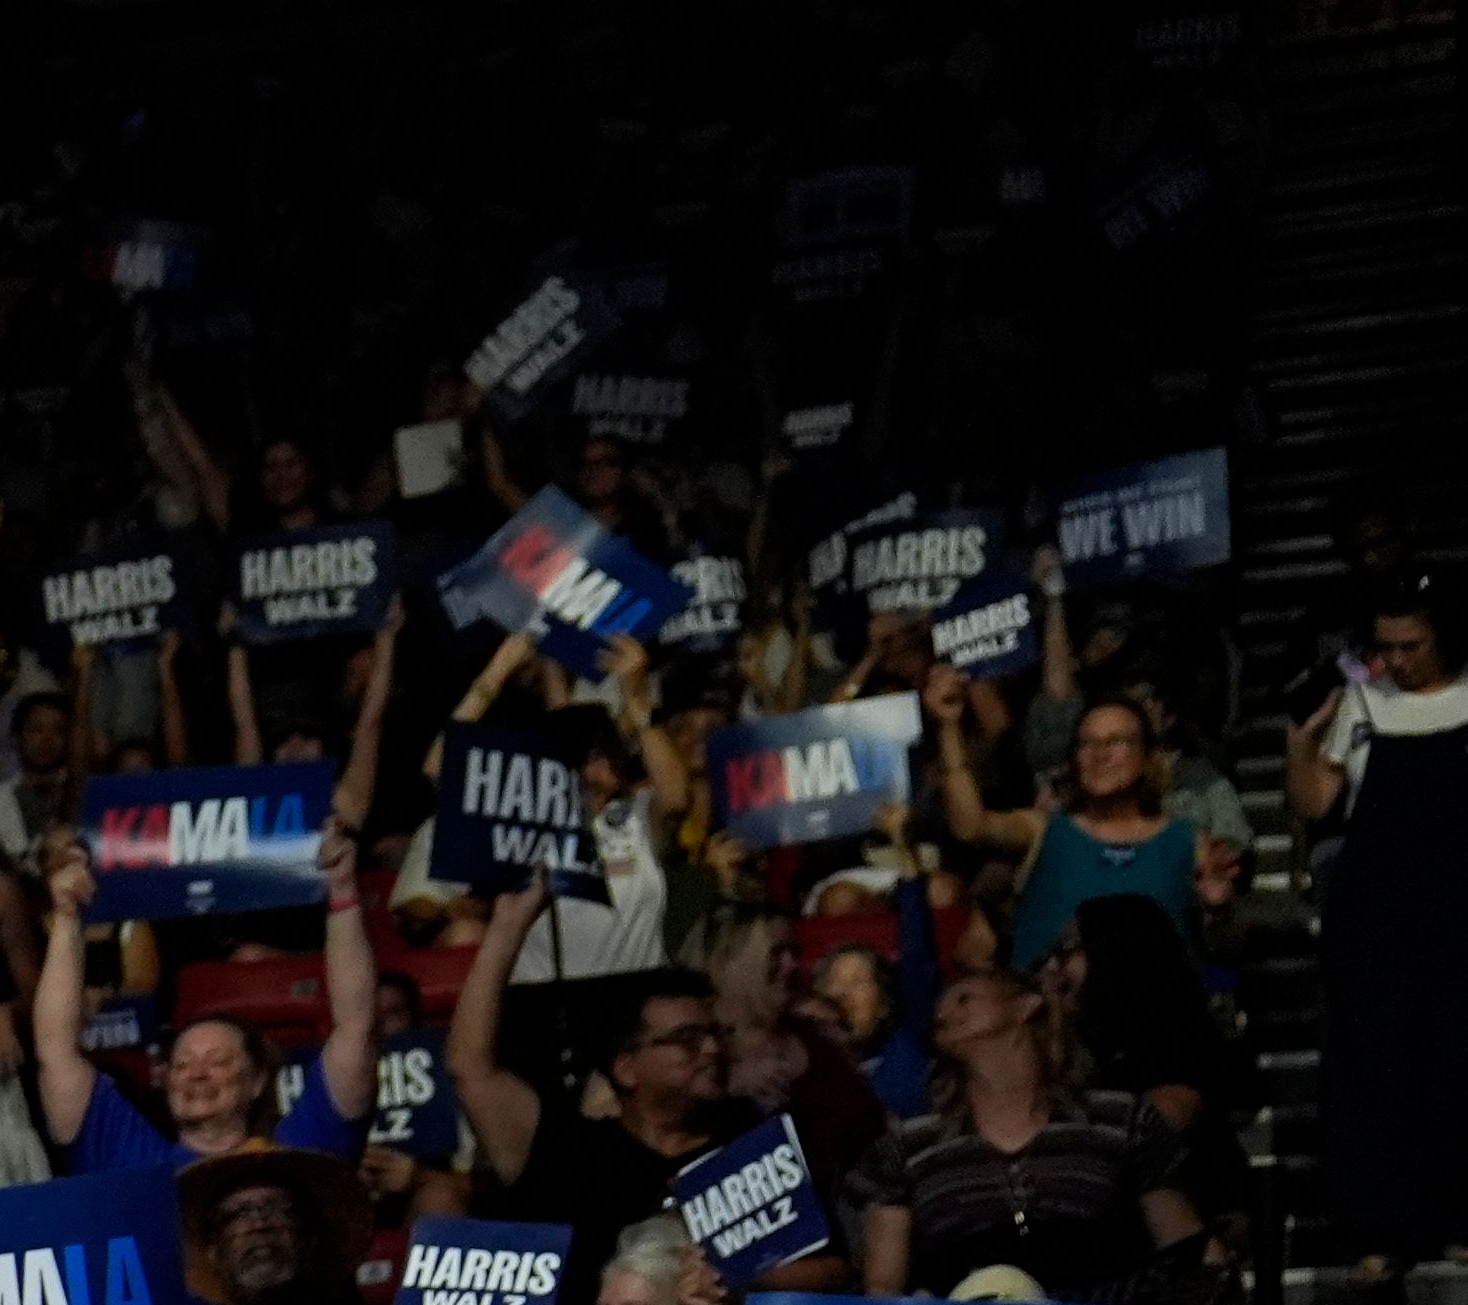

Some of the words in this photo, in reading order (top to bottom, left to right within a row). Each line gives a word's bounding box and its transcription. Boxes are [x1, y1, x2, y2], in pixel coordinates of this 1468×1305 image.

[42, 554, 178, 625] HARRIS
[238, 535, 380, 601] HARRIS
[852, 525, 988, 592] HARRIS
[263, 590, 360, 626] WALZ
[681, 1140, 801, 1246] HARRIS
[713, 1200, 801, 1260] WALZ
[401, 1243, 562, 1298] HARRIS
